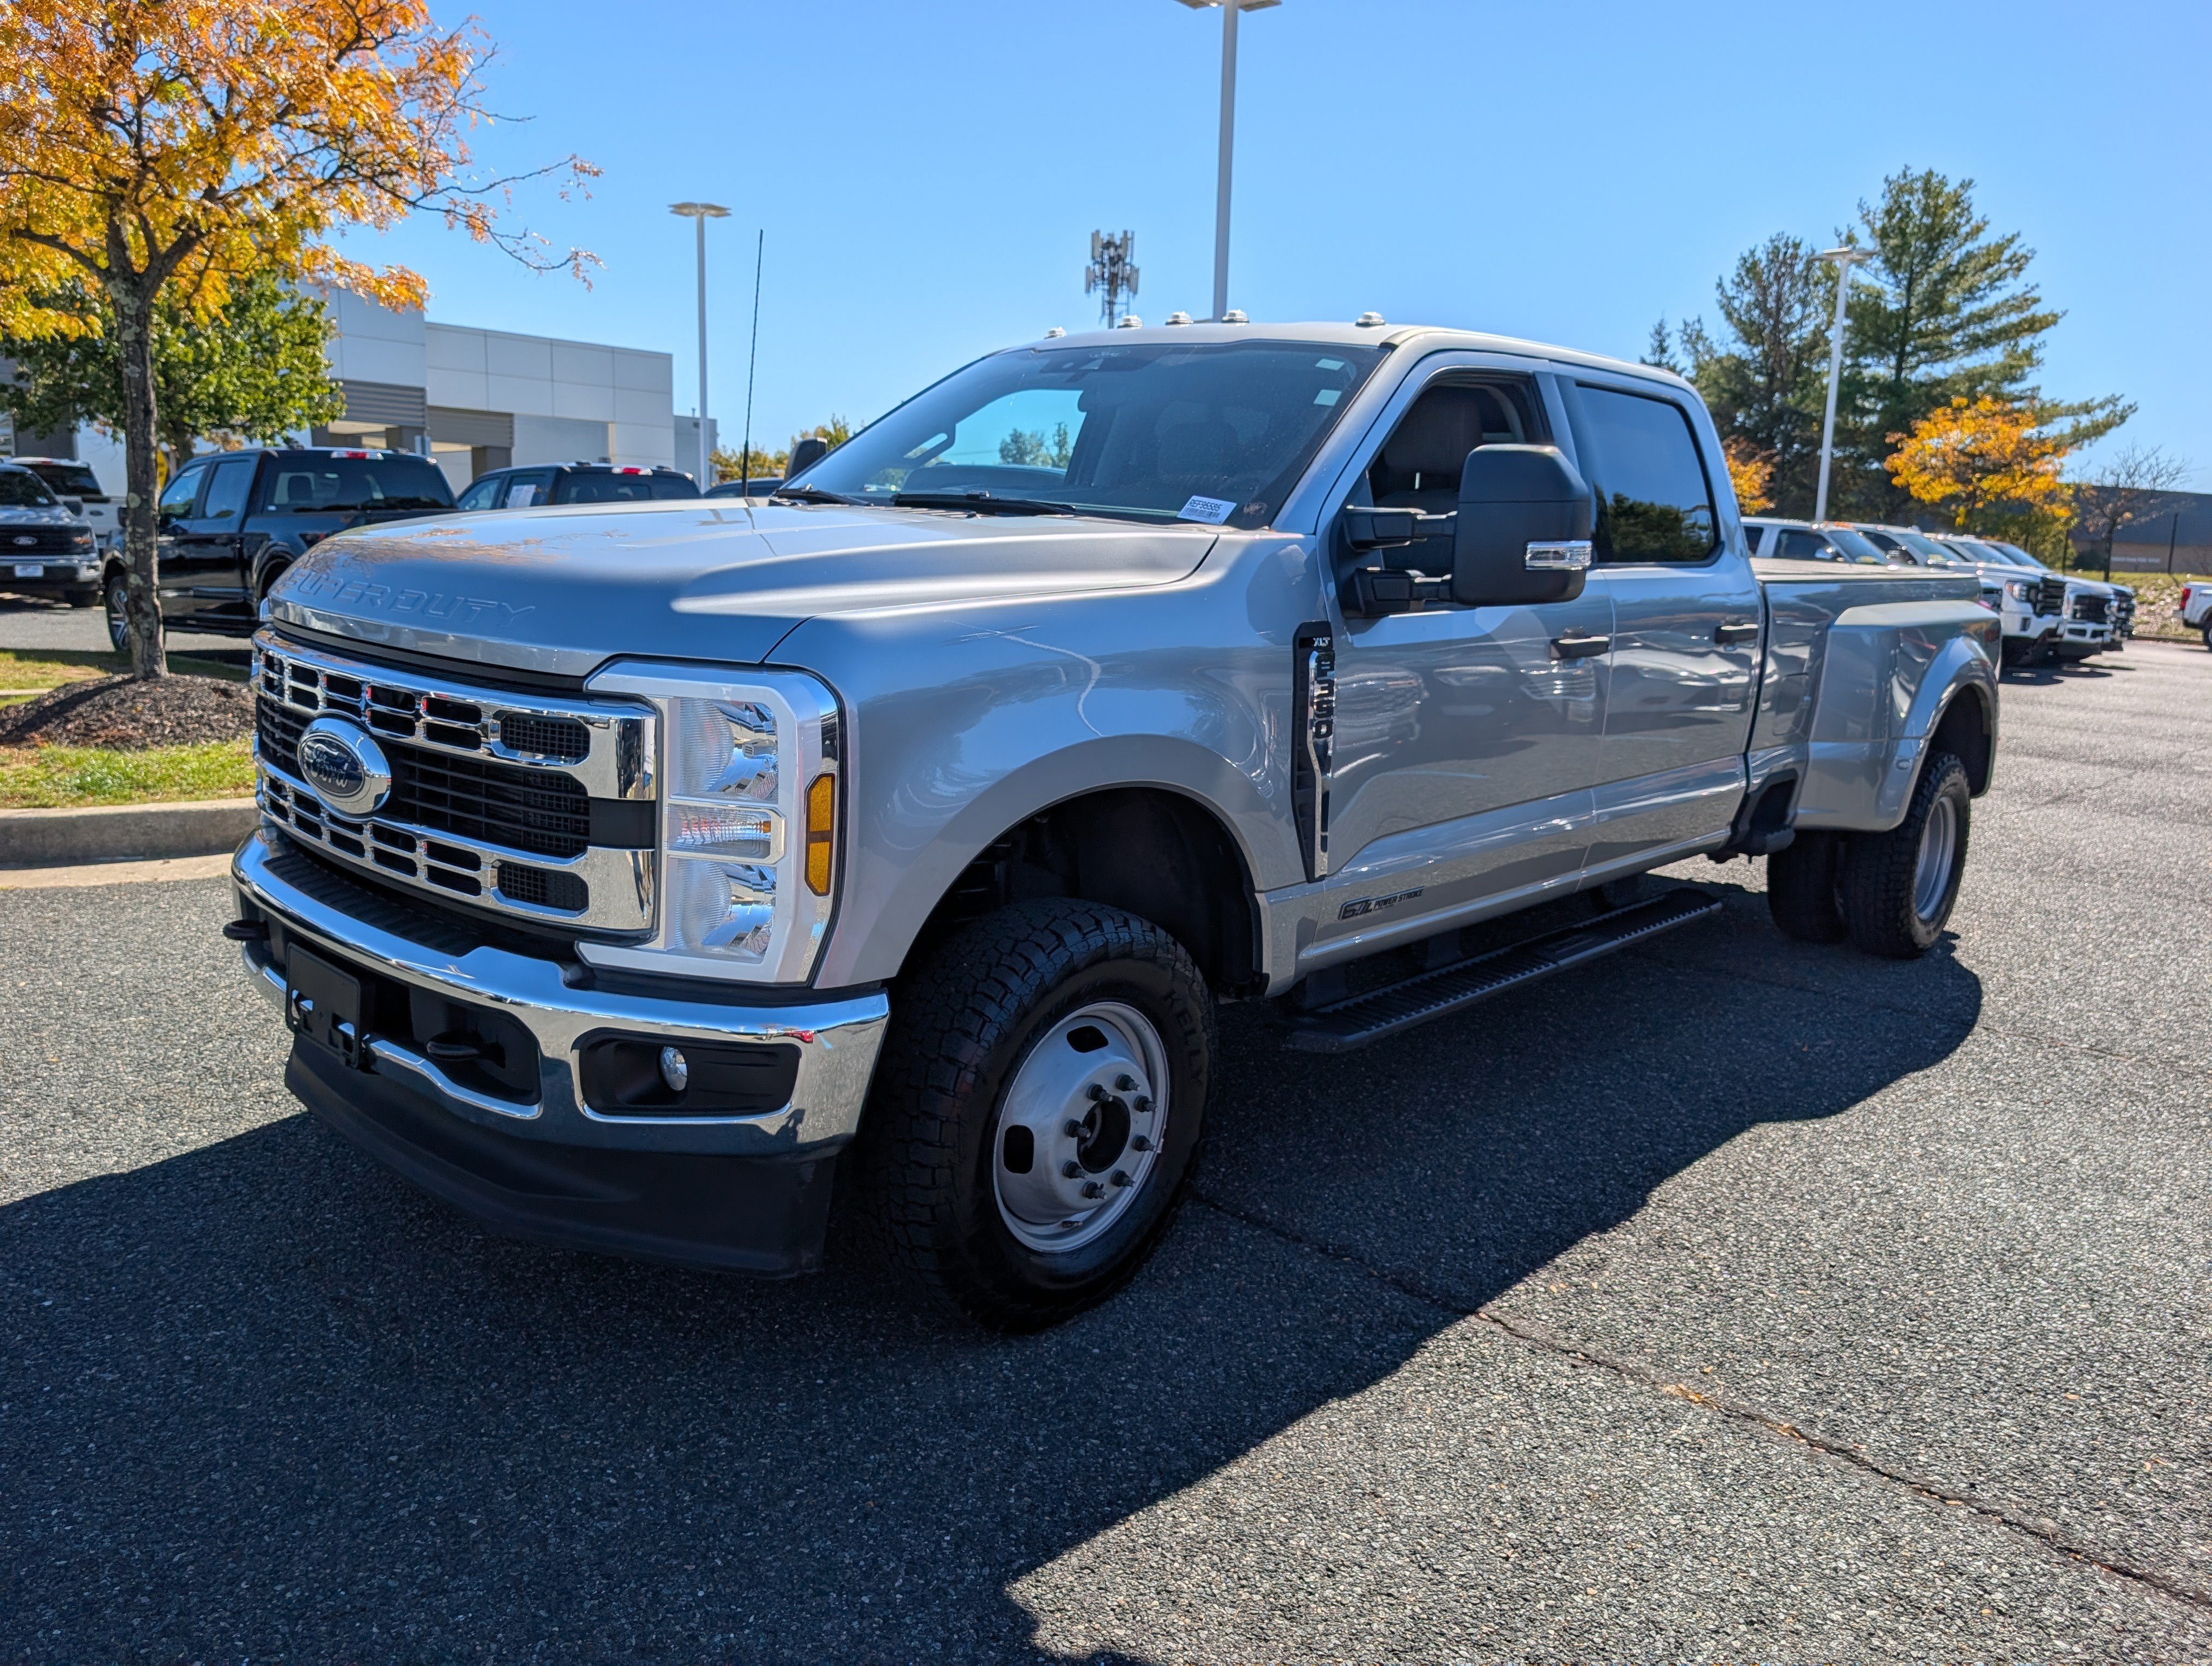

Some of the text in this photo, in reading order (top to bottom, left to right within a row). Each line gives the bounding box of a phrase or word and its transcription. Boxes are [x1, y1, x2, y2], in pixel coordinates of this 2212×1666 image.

[288, 567, 536, 627] SUPER DUTY
[1313, 636, 1330, 647] XLT
[1374, 896, 1398, 908] POWER
[1397, 889, 1423, 902] STROKE
[1162, 989, 1203, 1084] KELLY
